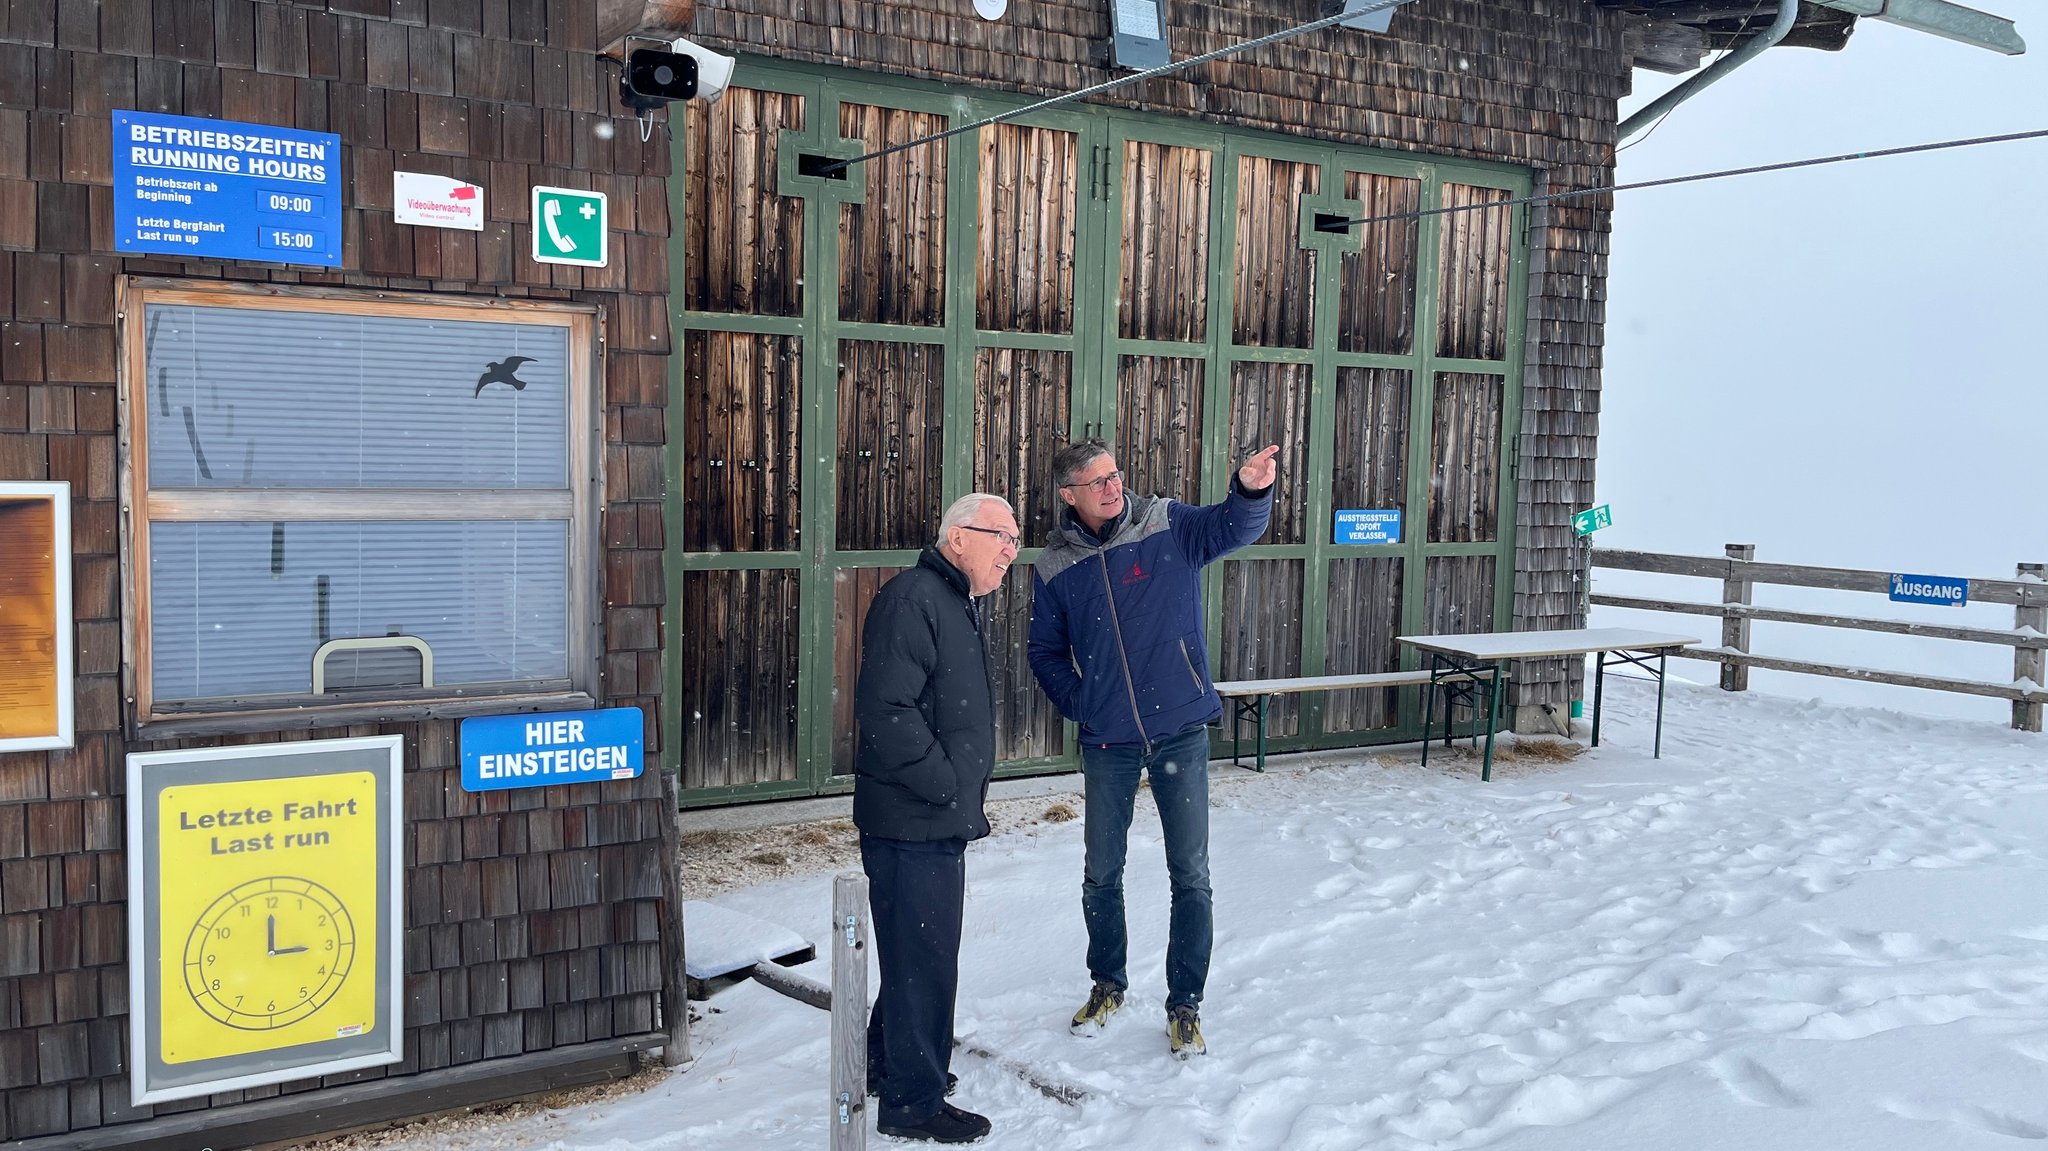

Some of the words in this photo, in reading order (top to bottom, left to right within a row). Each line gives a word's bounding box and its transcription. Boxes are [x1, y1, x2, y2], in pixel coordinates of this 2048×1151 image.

[131, 125, 325, 161] BETRIEBSZEITEN
[131, 146, 240, 172] RUNNING
[249, 158, 326, 181] HOURS
[136, 176, 201, 191] Betriebszeit
[204, 181, 218, 192] ab
[136, 190, 192, 204] Beginning
[270, 195, 311, 213] 09:00
[407, 198, 471, 216] Videoüberwachung
[137, 216, 171, 228] Letzte
[173, 219, 225, 233] Bergfahrt
[137, 230, 161, 241] Last
[164, 233, 182, 242] run
[185, 235, 199, 245] up
[272, 232, 313, 248] 15:00
[1338, 514, 1398, 522] AUSSTIEGSSTELLE
[1355, 523, 1381, 531] SOFORT
[1349, 532, 1387, 540] VERLASSEN
[1894, 583, 1962, 599] AUSGANG
[526, 720, 585, 746] HIER
[479, 746, 628, 779] EINSTEIGEN
[180, 807, 272, 830] Letzte
[284, 798, 357, 822] Fahrt
[211, 833, 274, 855] Last
[284, 830, 330, 849] run
[265, 896, 278, 909] 12
[297, 899, 302, 911] 1
[240, 905, 250, 917] 11
[318, 915, 326, 927] 2
[215, 927, 231, 939] 10
[325, 939, 333, 951] 3
[207, 955, 216, 966] 9
[318, 965, 326, 976] 4
[212, 979, 221, 991] 8
[300, 986, 308, 998] 5
[235, 995, 244, 1008] 7
[267, 1000, 275, 1012] 6
